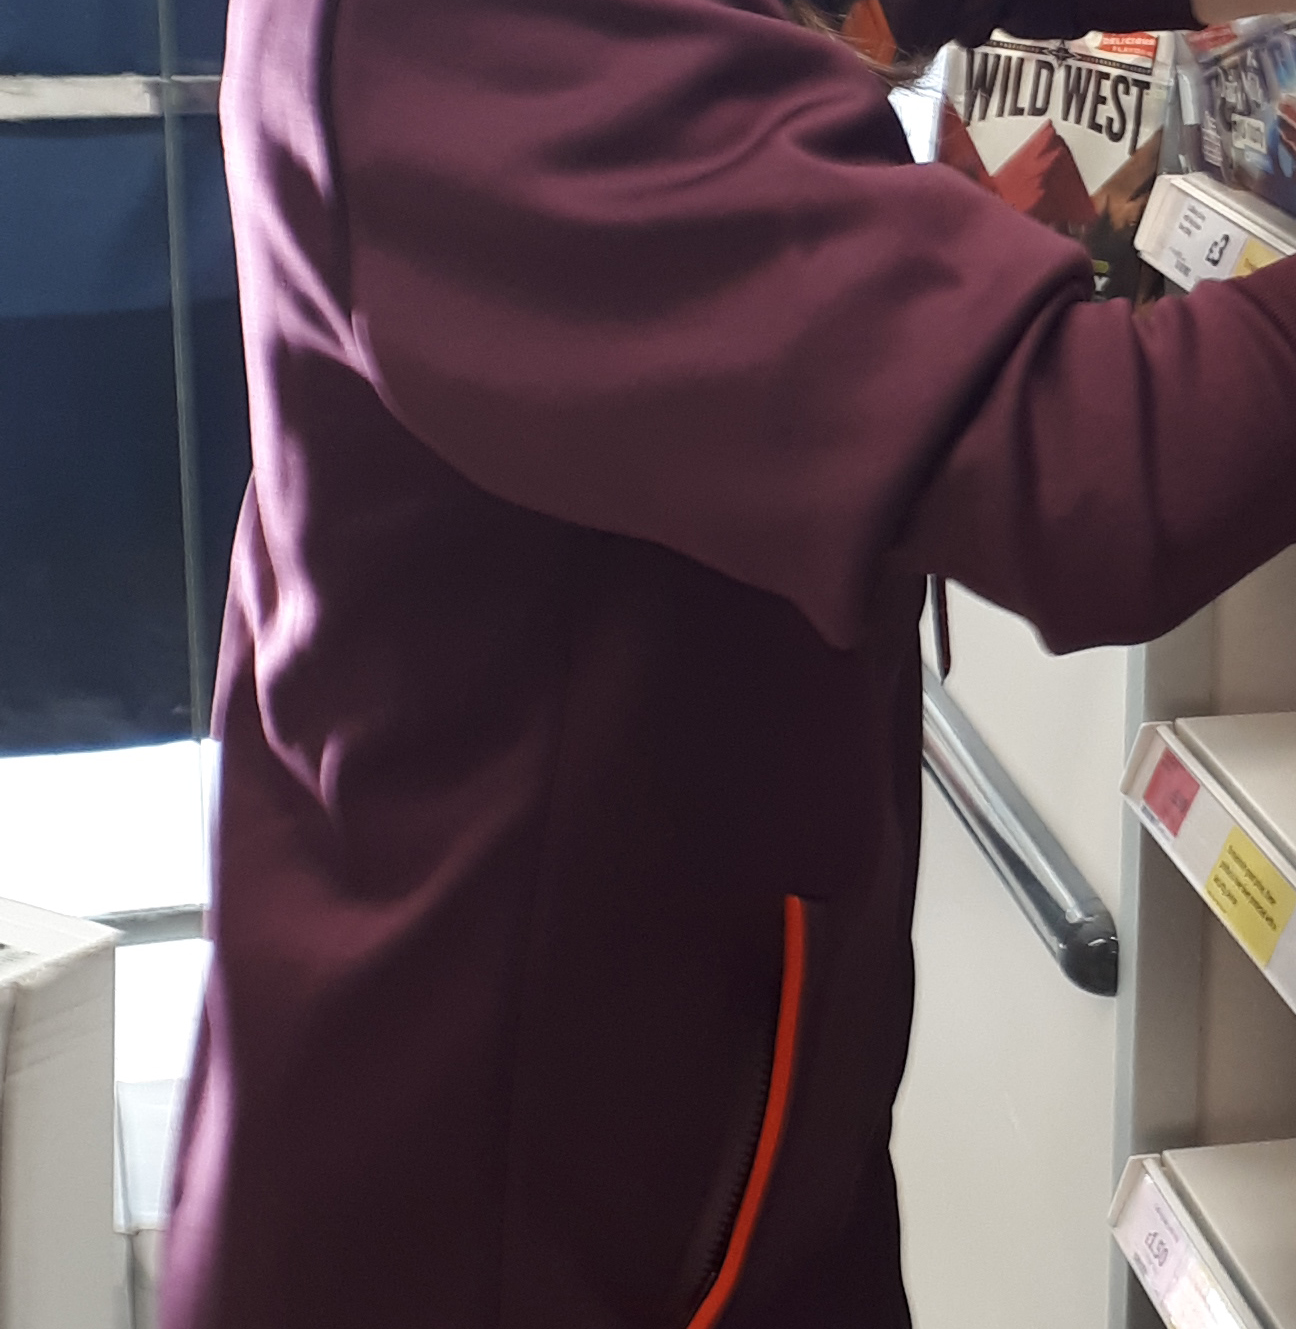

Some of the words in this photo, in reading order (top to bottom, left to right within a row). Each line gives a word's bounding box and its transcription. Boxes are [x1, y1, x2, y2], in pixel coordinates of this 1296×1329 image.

[1102, 36, 1156, 46] DELICIOUS
[963, 47, 1055, 129] WILD
[1060, 63, 1151, 157] WEST
